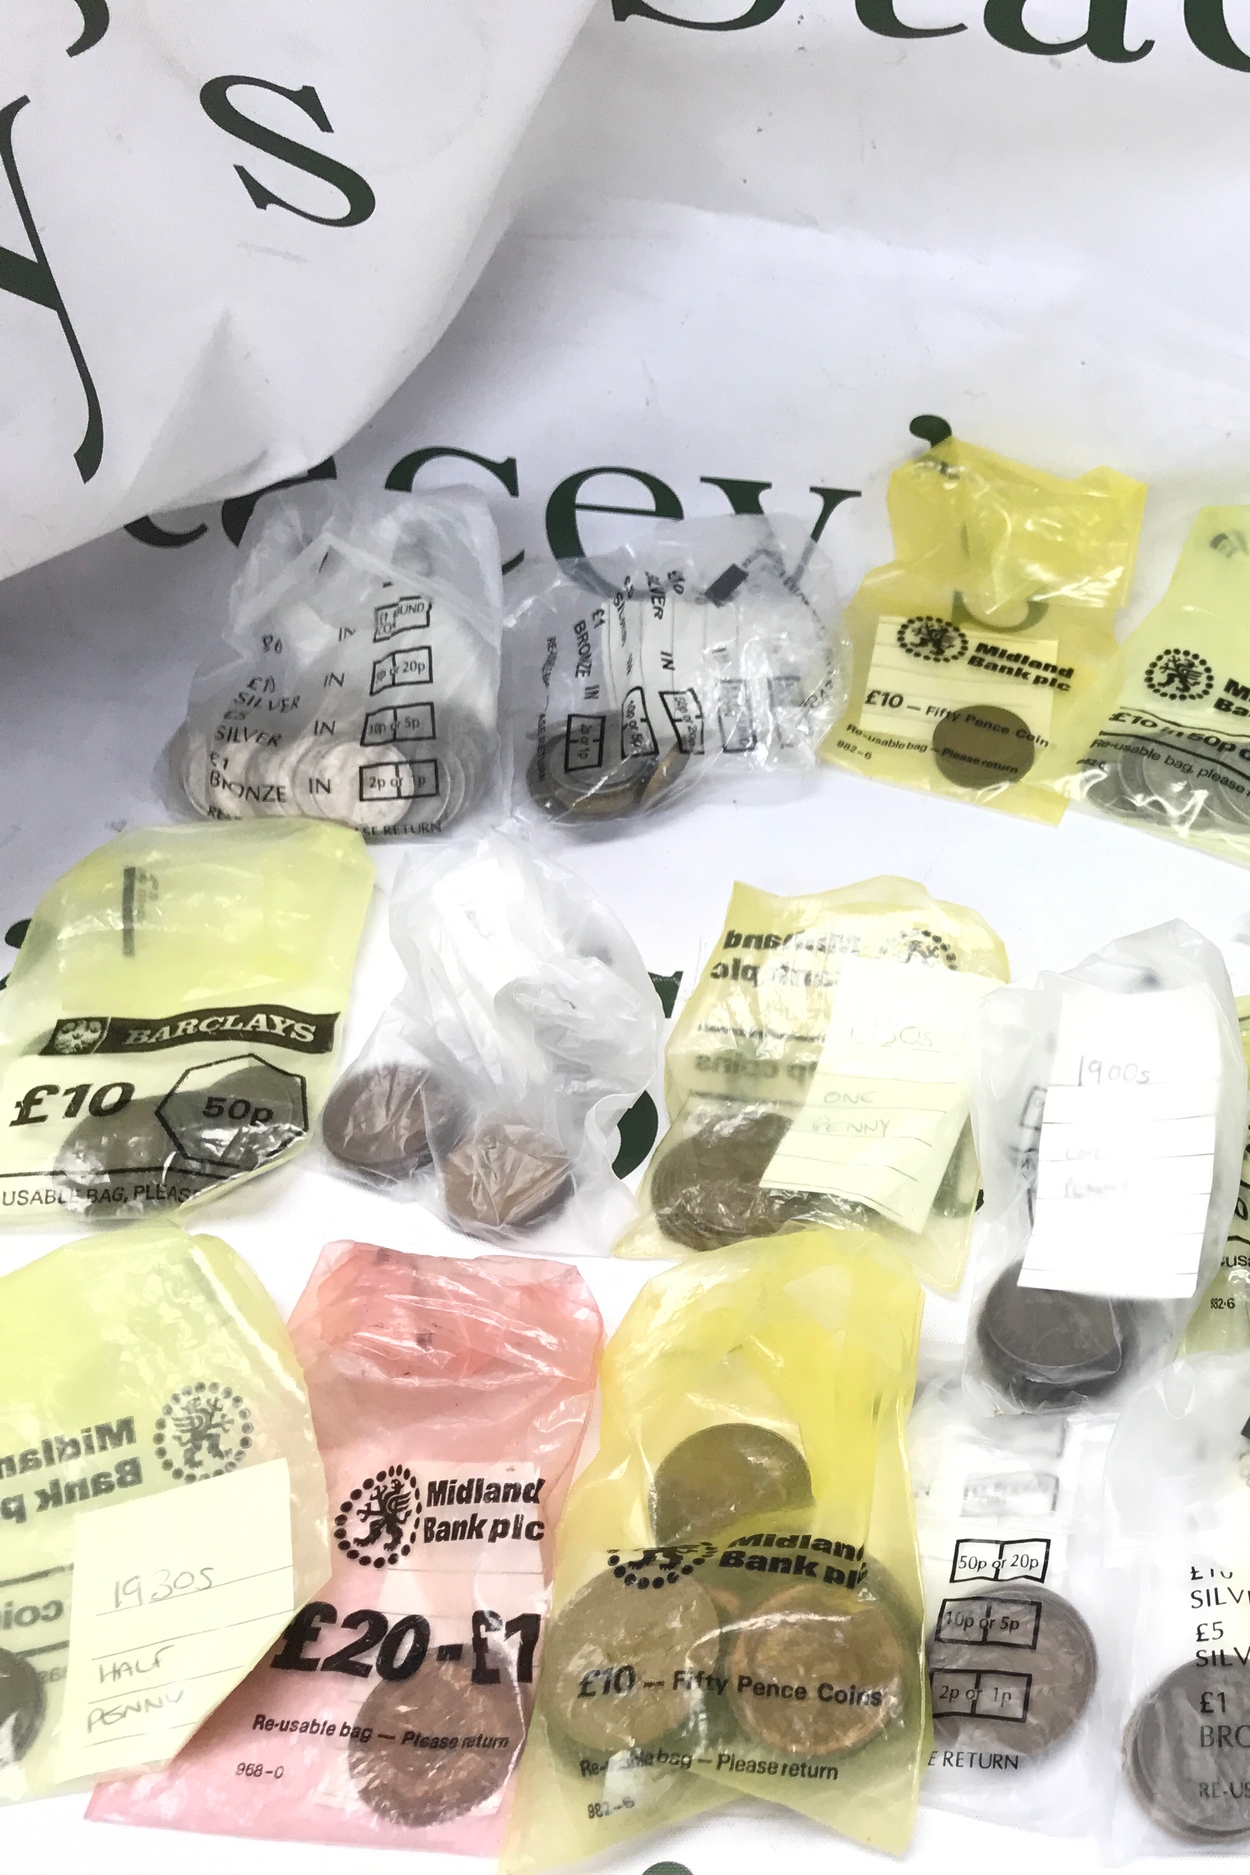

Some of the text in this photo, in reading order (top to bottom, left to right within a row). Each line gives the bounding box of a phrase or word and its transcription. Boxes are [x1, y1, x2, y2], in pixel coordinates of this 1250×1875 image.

[323, 673, 345, 687] IN
[402, 661, 426, 676] 20p
[573, 620, 600, 700] BRONZE IN
[661, 651, 675, 671] IN
[967, 655, 1072, 693] Bank plc
[974, 641, 1075, 681] Midland
[864, 689, 904, 709] £10
[925, 705, 961, 725] Fifty
[965, 715, 1010, 736] Pence
[214, 717, 421, 748] SILVER IN 5p
[846, 723, 903, 751] Re-usable
[903, 739, 929, 755] bag
[1108, 711, 1158, 729] £10
[1186, 731, 1238, 754] 50p
[1090, 738, 1161, 762] Re-usable
[1199, 766, 1245, 795] please
[209, 770, 286, 803] BRONZE
[308, 778, 332, 795] IN
[369, 776, 386, 790] 2p
[123, 1013, 317, 1048] BARCLAYS
[1077, 1055, 1151, 1087] 1900s
[9, 1082, 136, 1127] £10
[202, 1096, 274, 1125] 50p
[812, 1117, 891, 1137] PENNY
[426, 1477, 546, 1507] Midland
[423, 1512, 545, 1543] Bank plc
[719, 1550, 817, 1579] Bank
[958, 1553, 1039, 1572] 50p or 20p
[945, 1611, 1020, 1634] 10p or 5p
[1195, 1621, 1224, 1642] £5
[98, 1644, 175, 1684] HALF
[577, 1665, 884, 1707] £10 Fifty Pence Coins
[939, 1685, 1012, 1705] 2p or 1p
[1200, 1691, 1227, 1714] £1
[252, 1714, 336, 1737] Re-usable
[339, 1725, 373, 1743] bag
[400, 1730, 459, 1750] Please
[235, 1762, 285, 1779] 968-0
[716, 1753, 778, 1777] Please
[780, 1762, 839, 1780] return
[943, 1750, 1019, 1770] RETURN
